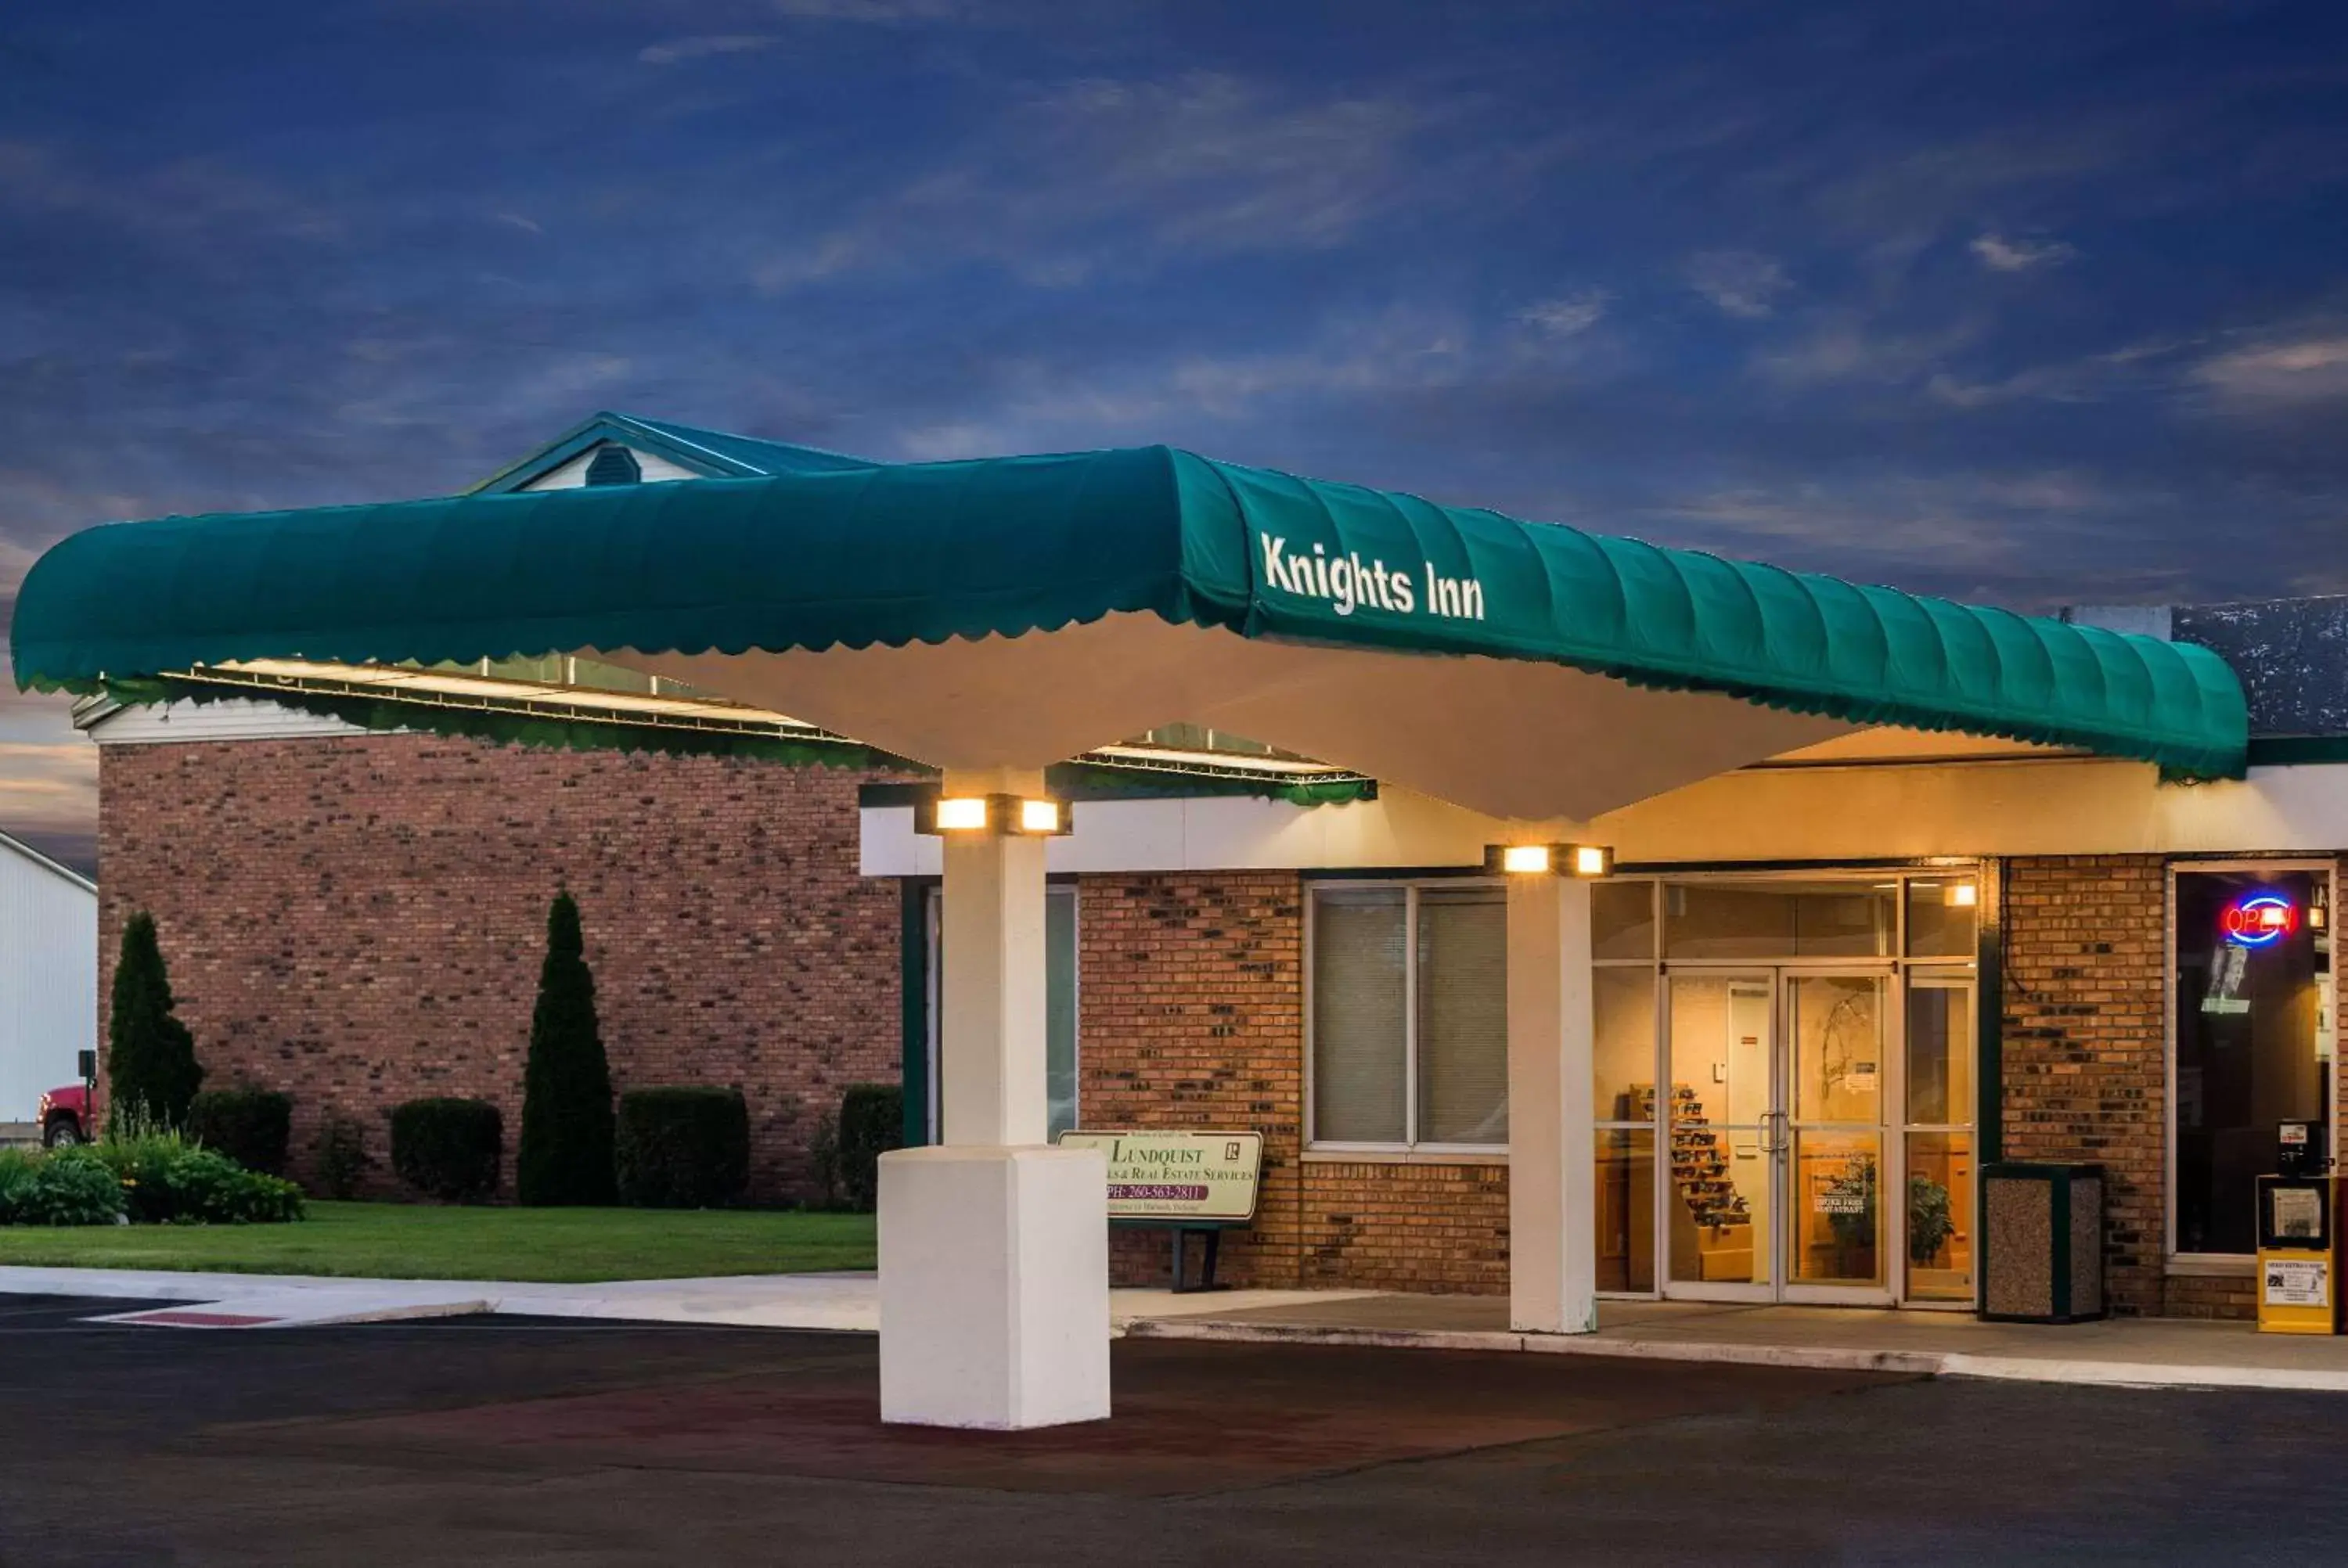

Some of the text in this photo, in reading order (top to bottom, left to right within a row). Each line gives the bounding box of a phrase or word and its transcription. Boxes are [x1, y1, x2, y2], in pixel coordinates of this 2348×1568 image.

[1261, 531, 1484, 620] Knights Inn
[1112, 1139, 1205, 1166] LUNDQUIST
[1129, 1185, 1199, 1199] 260-563-2811
